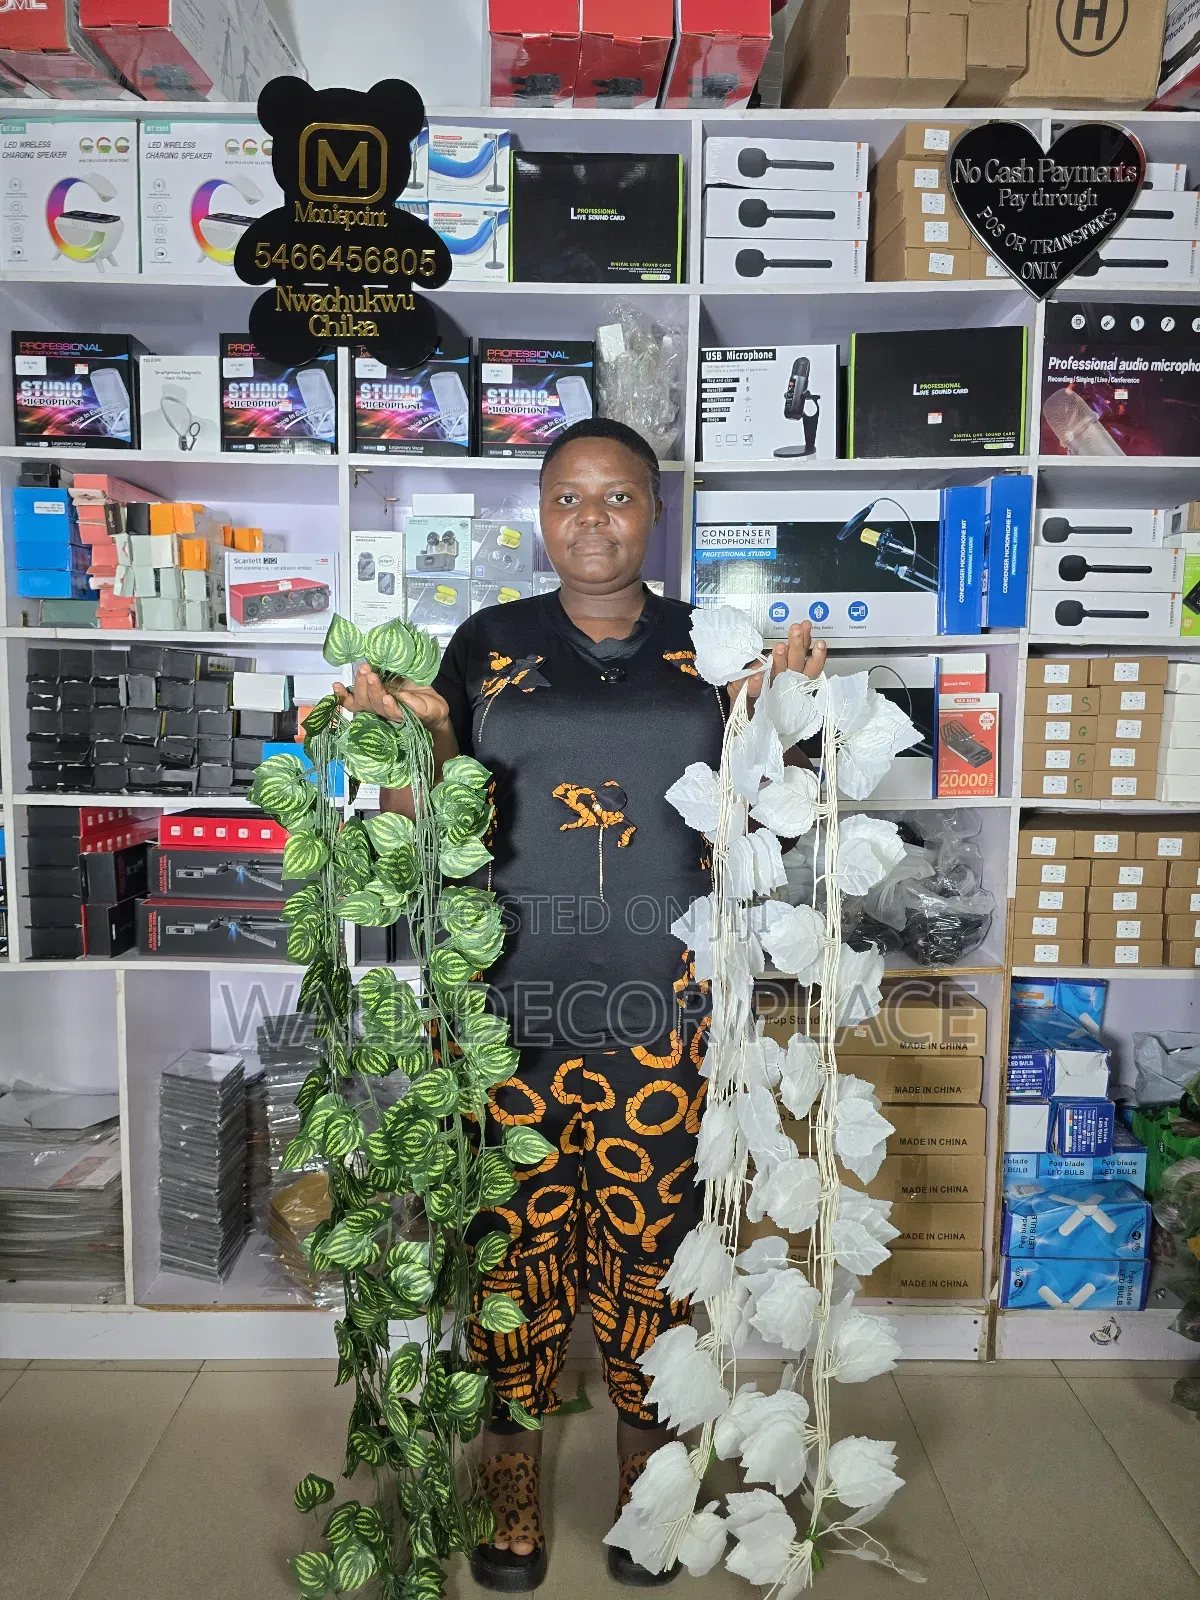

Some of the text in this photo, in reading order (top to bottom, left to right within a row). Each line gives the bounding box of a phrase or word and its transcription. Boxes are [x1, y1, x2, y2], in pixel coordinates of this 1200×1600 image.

[2, 151, 67, 159] CHARGING SPEAKER
[146, 152, 212, 160] CHARGING SPEAKER
[317, 139, 368, 189] M
[953, 158, 1137, 190] No Cash Payments
[998, 187, 1098, 212] Pay through
[294, 201, 388, 231] Moniepoint
[977, 206, 1118, 255] POS OR TRANSFERS
[254, 242, 437, 277] 5466456805
[1021, 260, 1063, 280] ONLY
[275, 286, 415, 313] Nwachukwu
[308, 314, 380, 337] Chika
[20, 342, 103, 351] PROFESSIONAL
[487, 350, 570, 359] PROFESSIONAL
[705, 350, 774, 362] USB Microphone
[1048, 356, 1149, 372] Professional audio
[21, 381, 83, 397] STUDIO
[229, 382, 289, 399] STUDIO
[360, 383, 423, 401] STUDIO
[931, 388, 953, 396] SOUND
[953, 387, 969, 395] CARD
[22, 398, 84, 406] MICROPHONE
[487, 389, 548, 406] STUDIO
[487, 406, 548, 415] MICROPHONE
[701, 529, 771, 538] CONDENSER
[701, 537, 771, 546] MICROPHONE KIT
[1003, 519, 1012, 558] MICROPHONE
[959, 529, 967, 568] MICROPHONE
[233, 557, 262, 565] Scarlett
[1002, 558, 1010, 594] CONDENSER
[958, 568, 967, 603] CONDENSER
[940, 773, 989, 788] 20000
[900, 1042, 968, 1051] MADE IN CHINA
[894, 1086, 962, 1094] MADE IN CHINA
[900, 1138, 968, 1146] MADE IN CHINA
[901, 1186, 928, 1194] MADE
[929, 1186, 938, 1194] IN
[926, 1233, 935, 1241] IN
[936, 1233, 966, 1241] CHINA
[1028, 1235, 1036, 1250] LED
[901, 1280, 969, 1288] MADE IN CHINA
[1116, 1269, 1126, 1306] LED BULB
[1126, 1270, 1137, 1306] Fan blade
